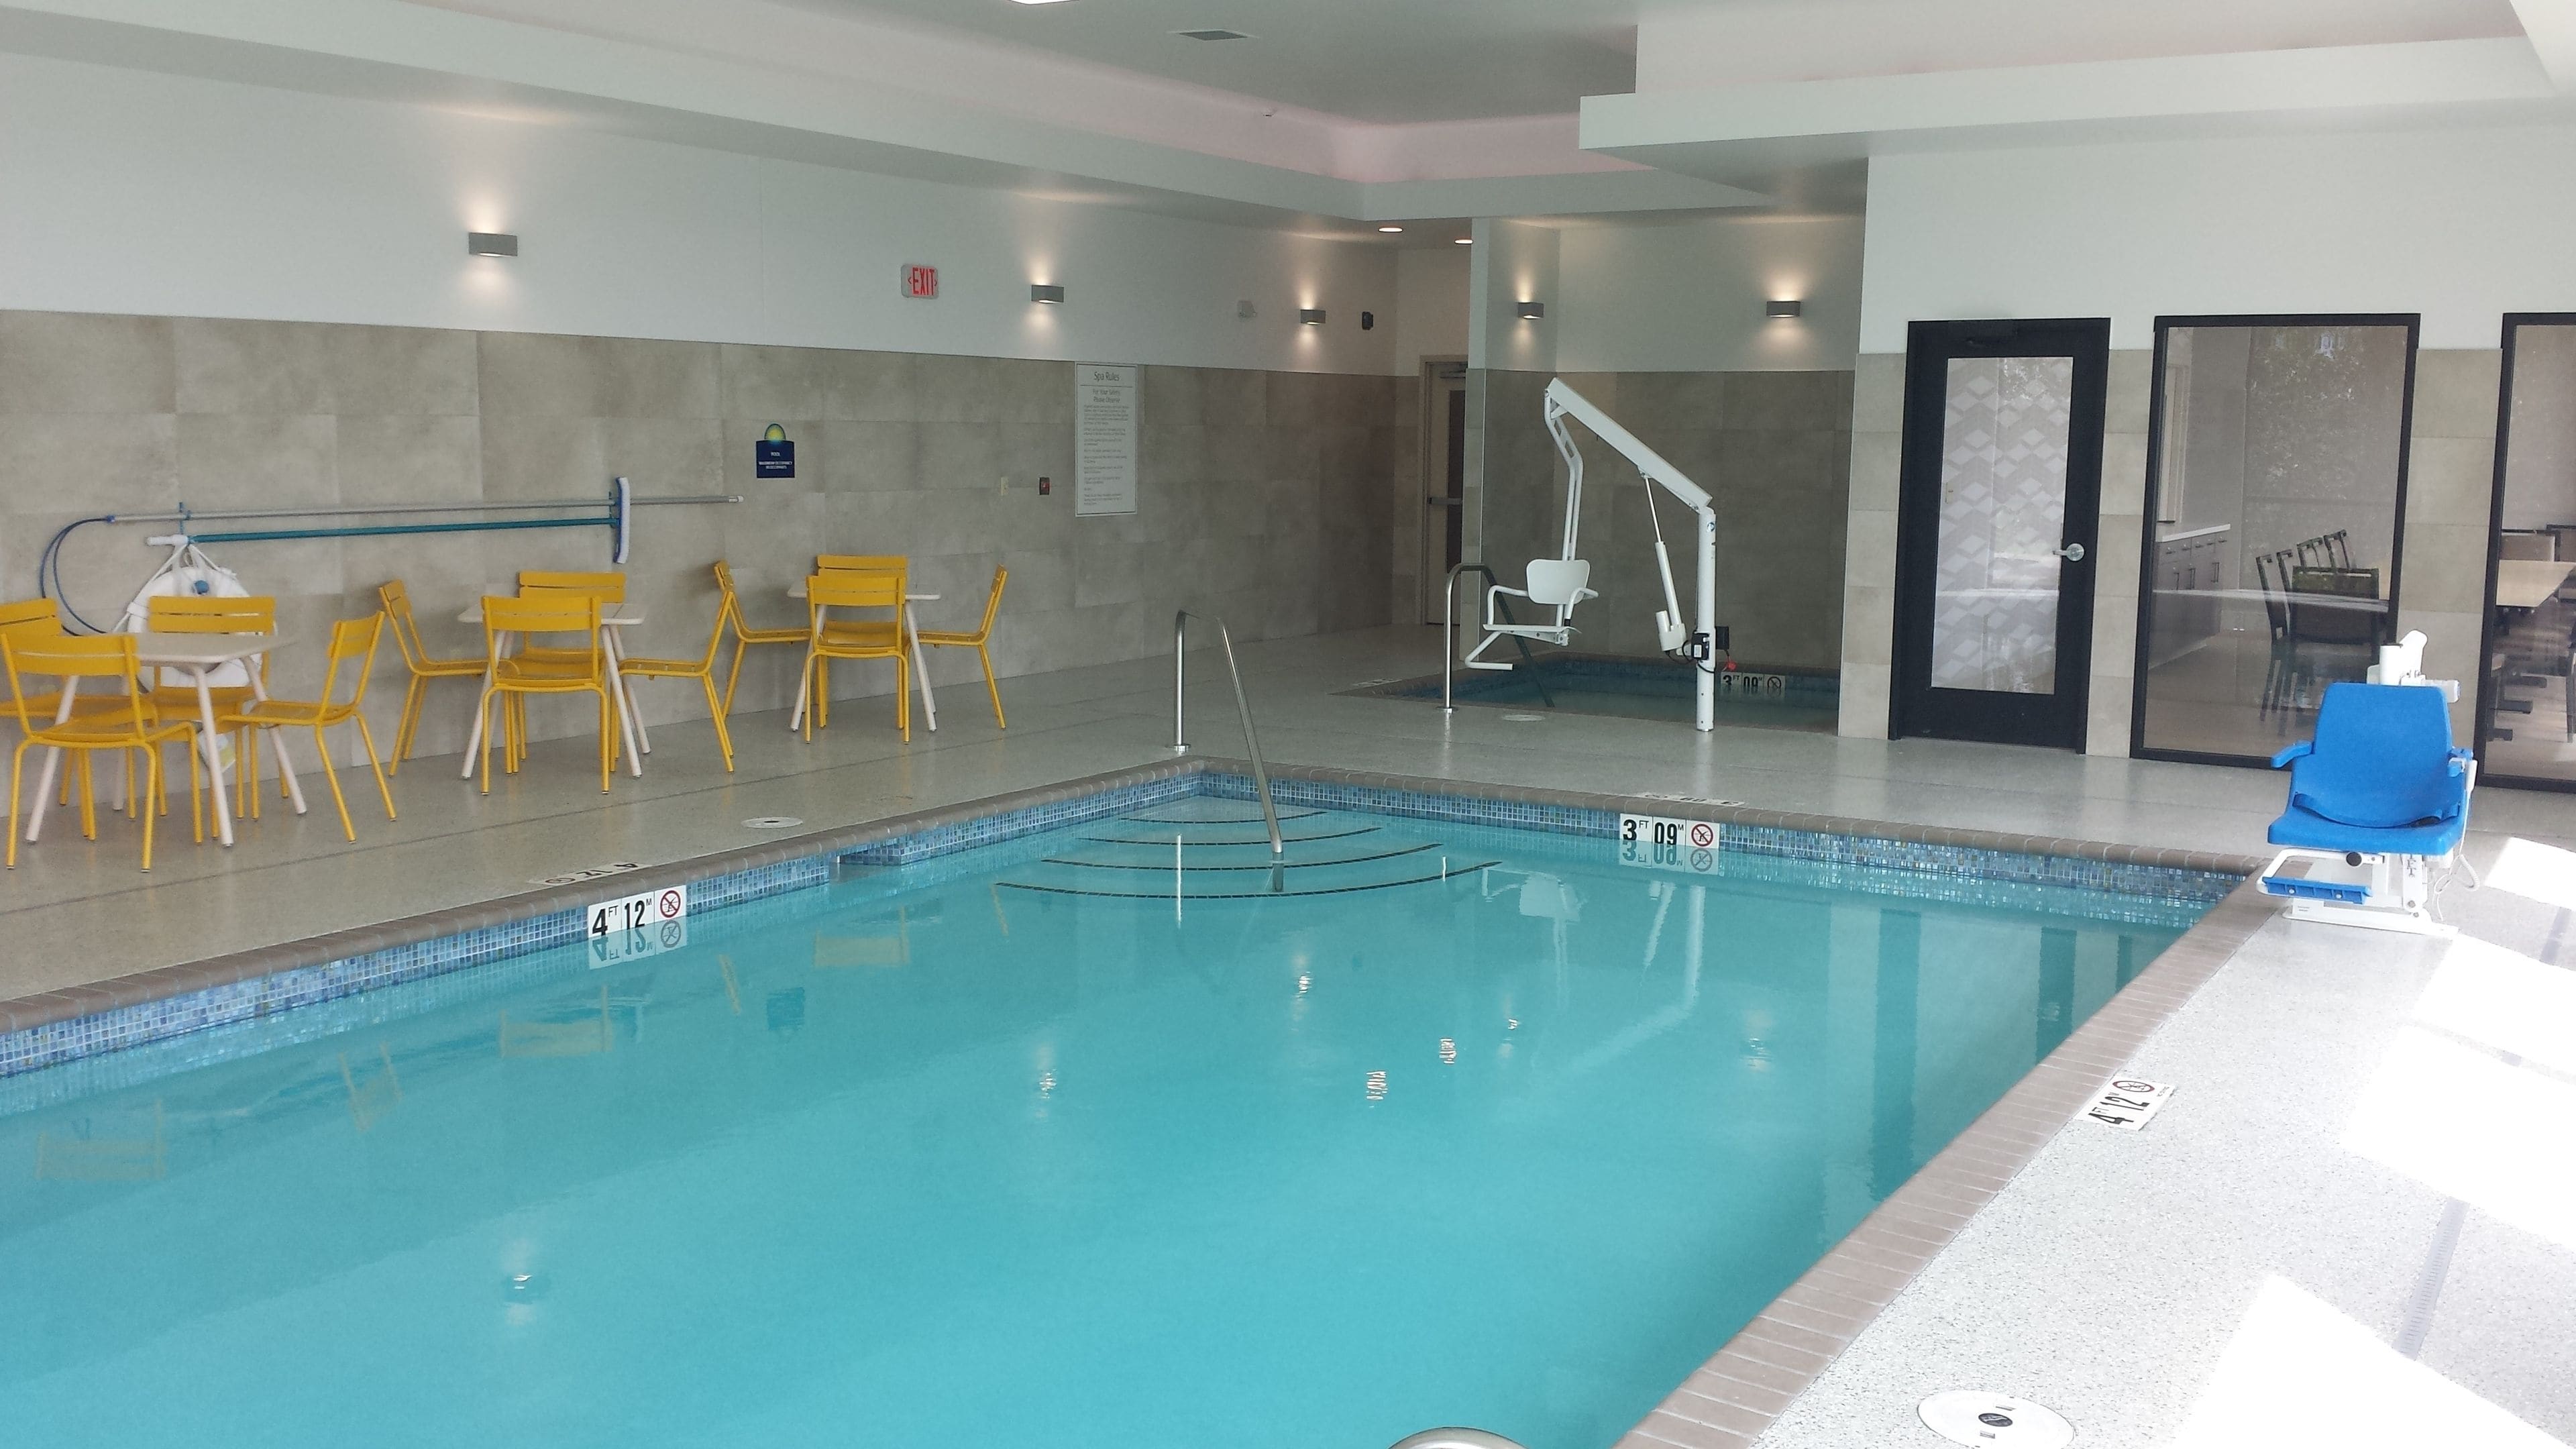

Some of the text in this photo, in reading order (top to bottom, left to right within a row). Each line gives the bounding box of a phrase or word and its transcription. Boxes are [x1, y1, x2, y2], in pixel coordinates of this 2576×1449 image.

[912, 267, 935, 296] EXIT
[1094, 371, 1120, 382] Spa Rules
[1623, 819, 1637, 841] 3
[592, 908, 609, 936] 4
[625, 900, 646, 930] 12
[2100, 1096, 2150, 1110] 12
[2088, 1113, 2135, 1124] 4
